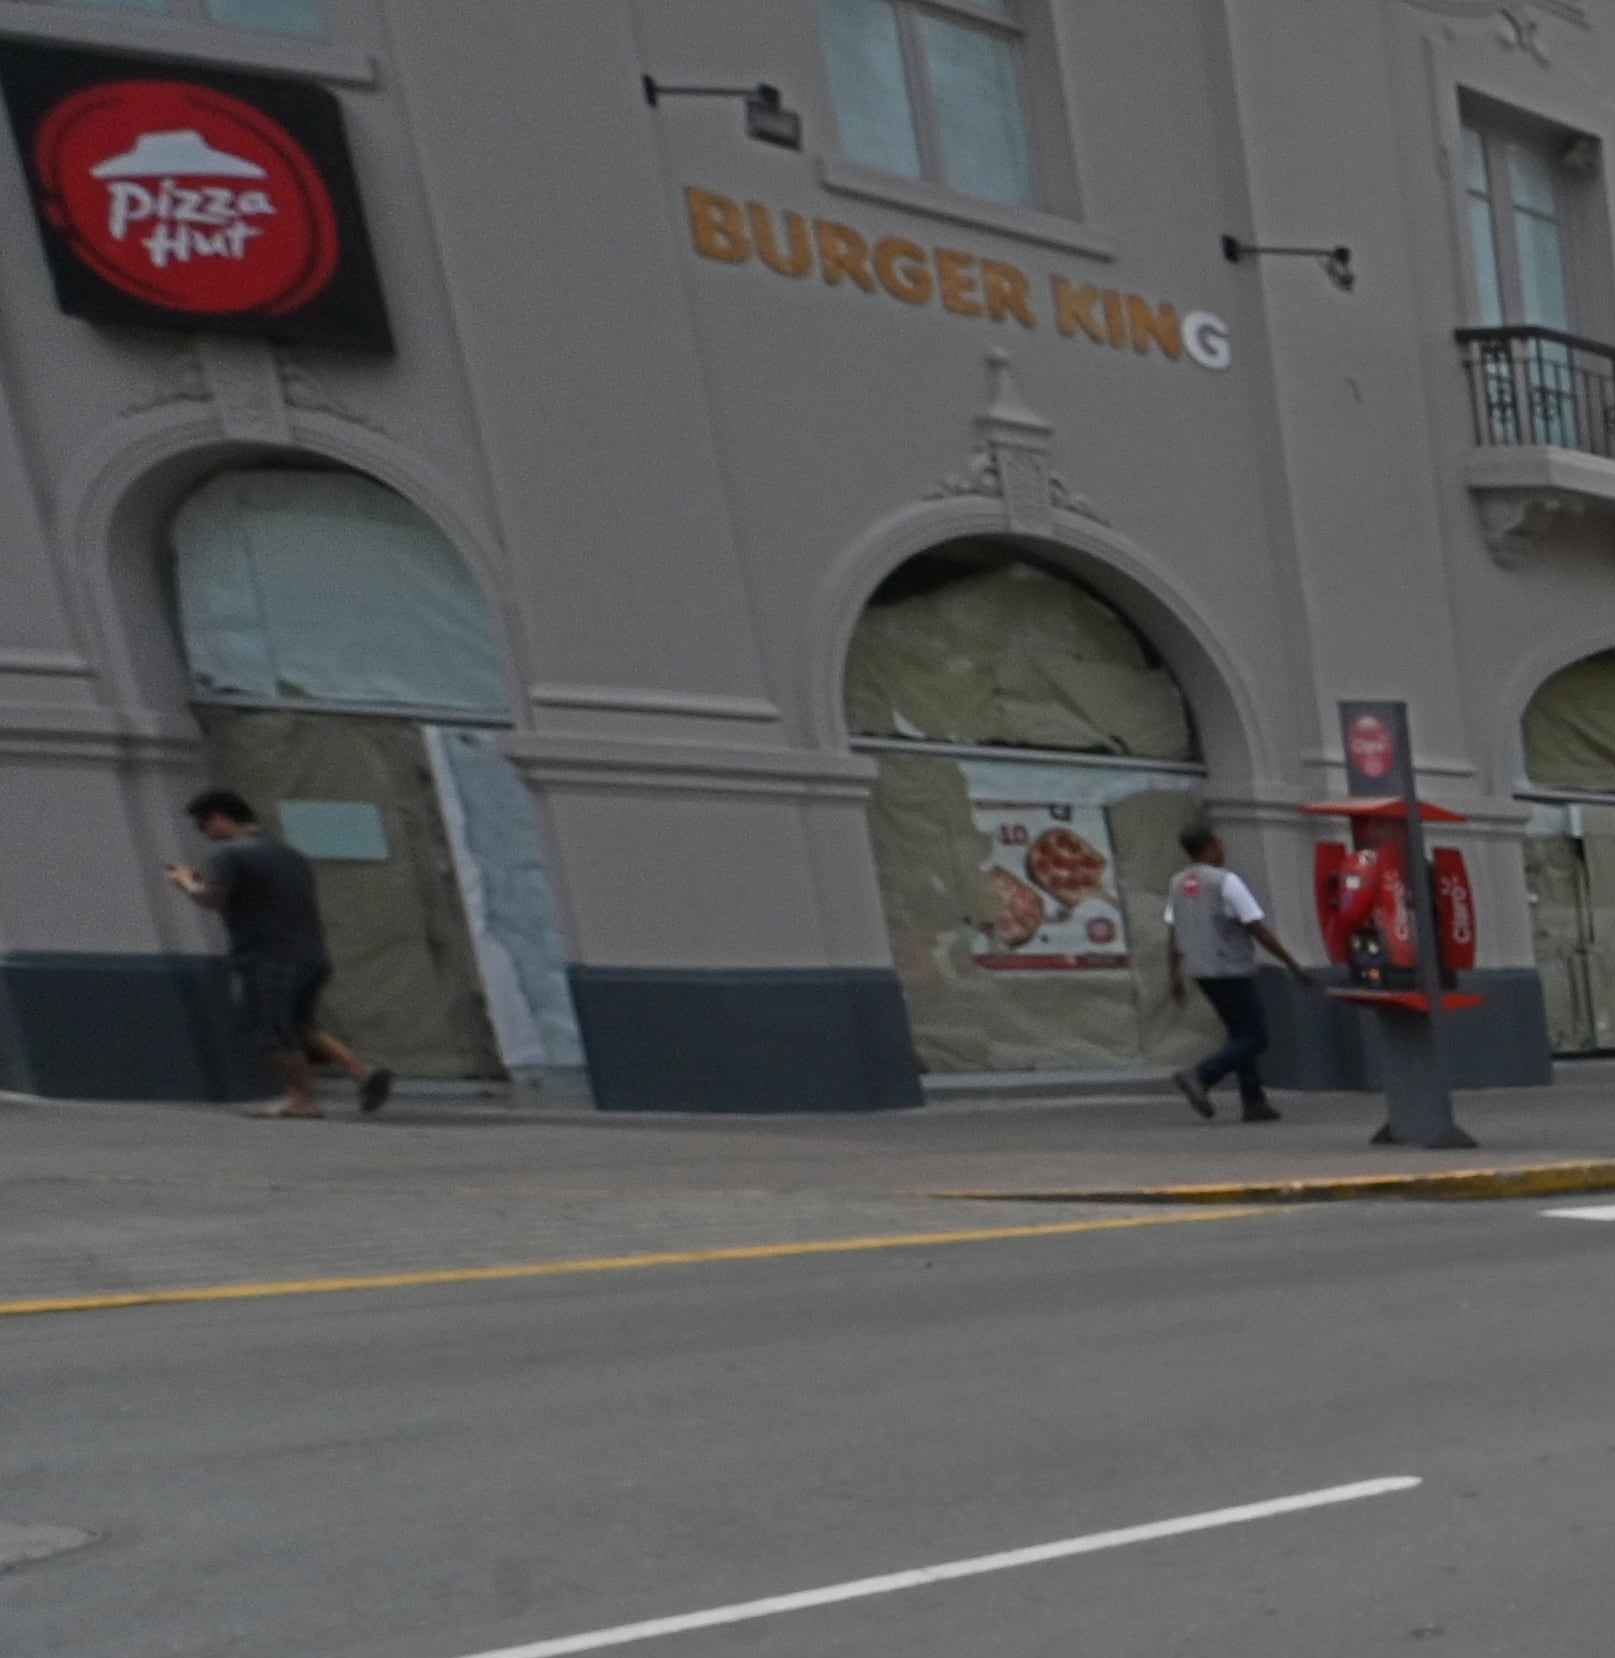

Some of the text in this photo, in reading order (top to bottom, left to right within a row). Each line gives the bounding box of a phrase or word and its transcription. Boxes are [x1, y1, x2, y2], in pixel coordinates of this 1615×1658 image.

[107, 178, 277, 240] Pizza
[141, 220, 263, 268] Hut
[683, 185, 1232, 371] BURGER KING
